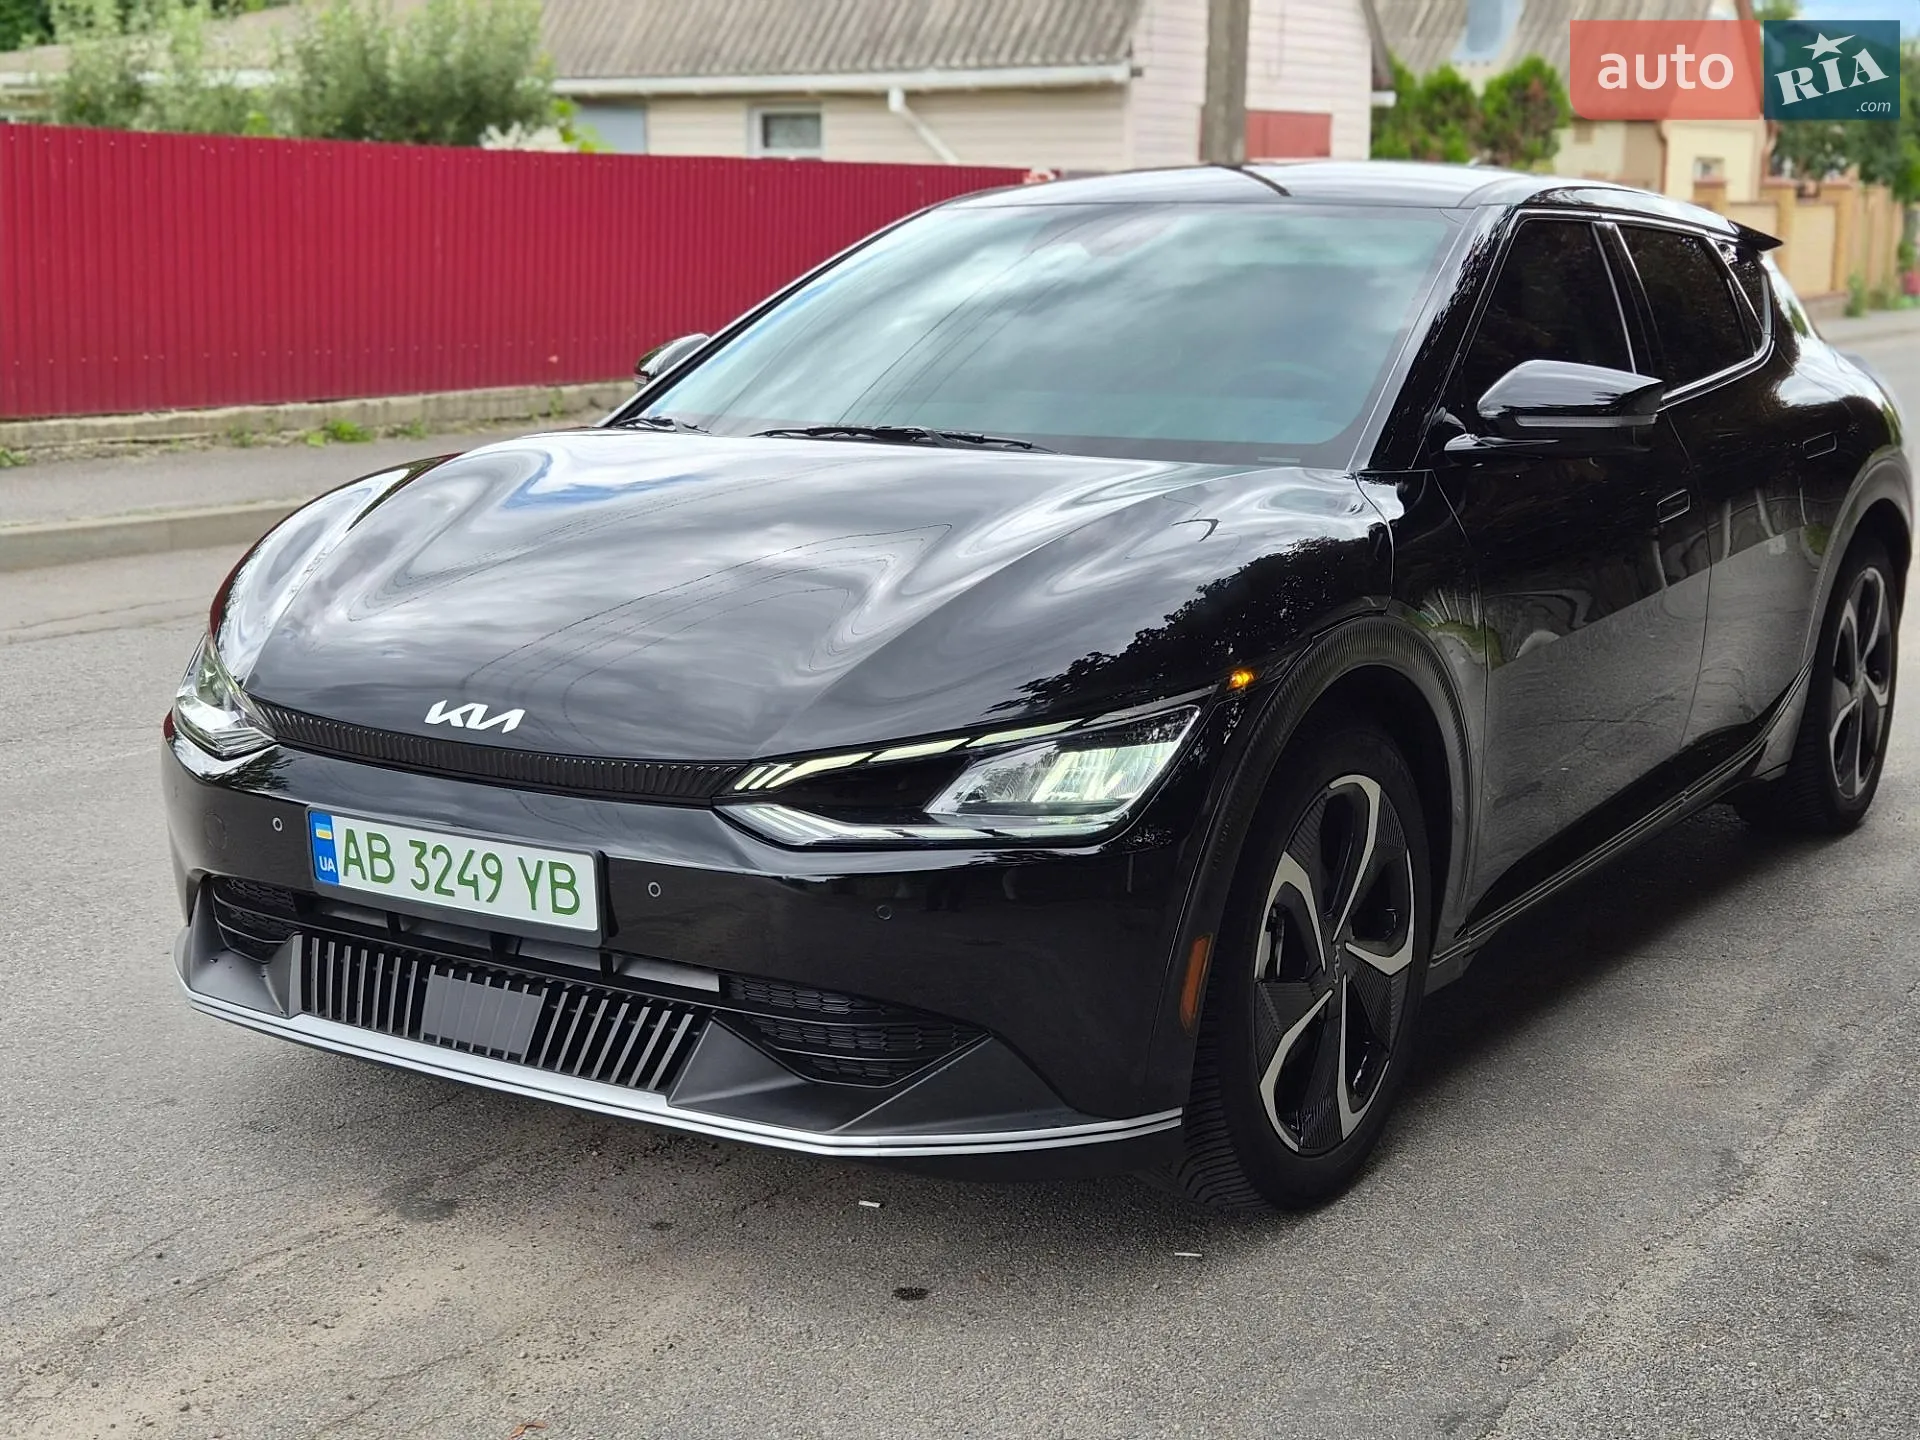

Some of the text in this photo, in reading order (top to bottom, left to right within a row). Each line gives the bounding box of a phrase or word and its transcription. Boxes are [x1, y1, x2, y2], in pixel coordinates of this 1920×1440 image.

[424, 700, 526, 733] KIA
[319, 856, 336, 873] UA
[343, 828, 580, 915] AB 3249 YB
